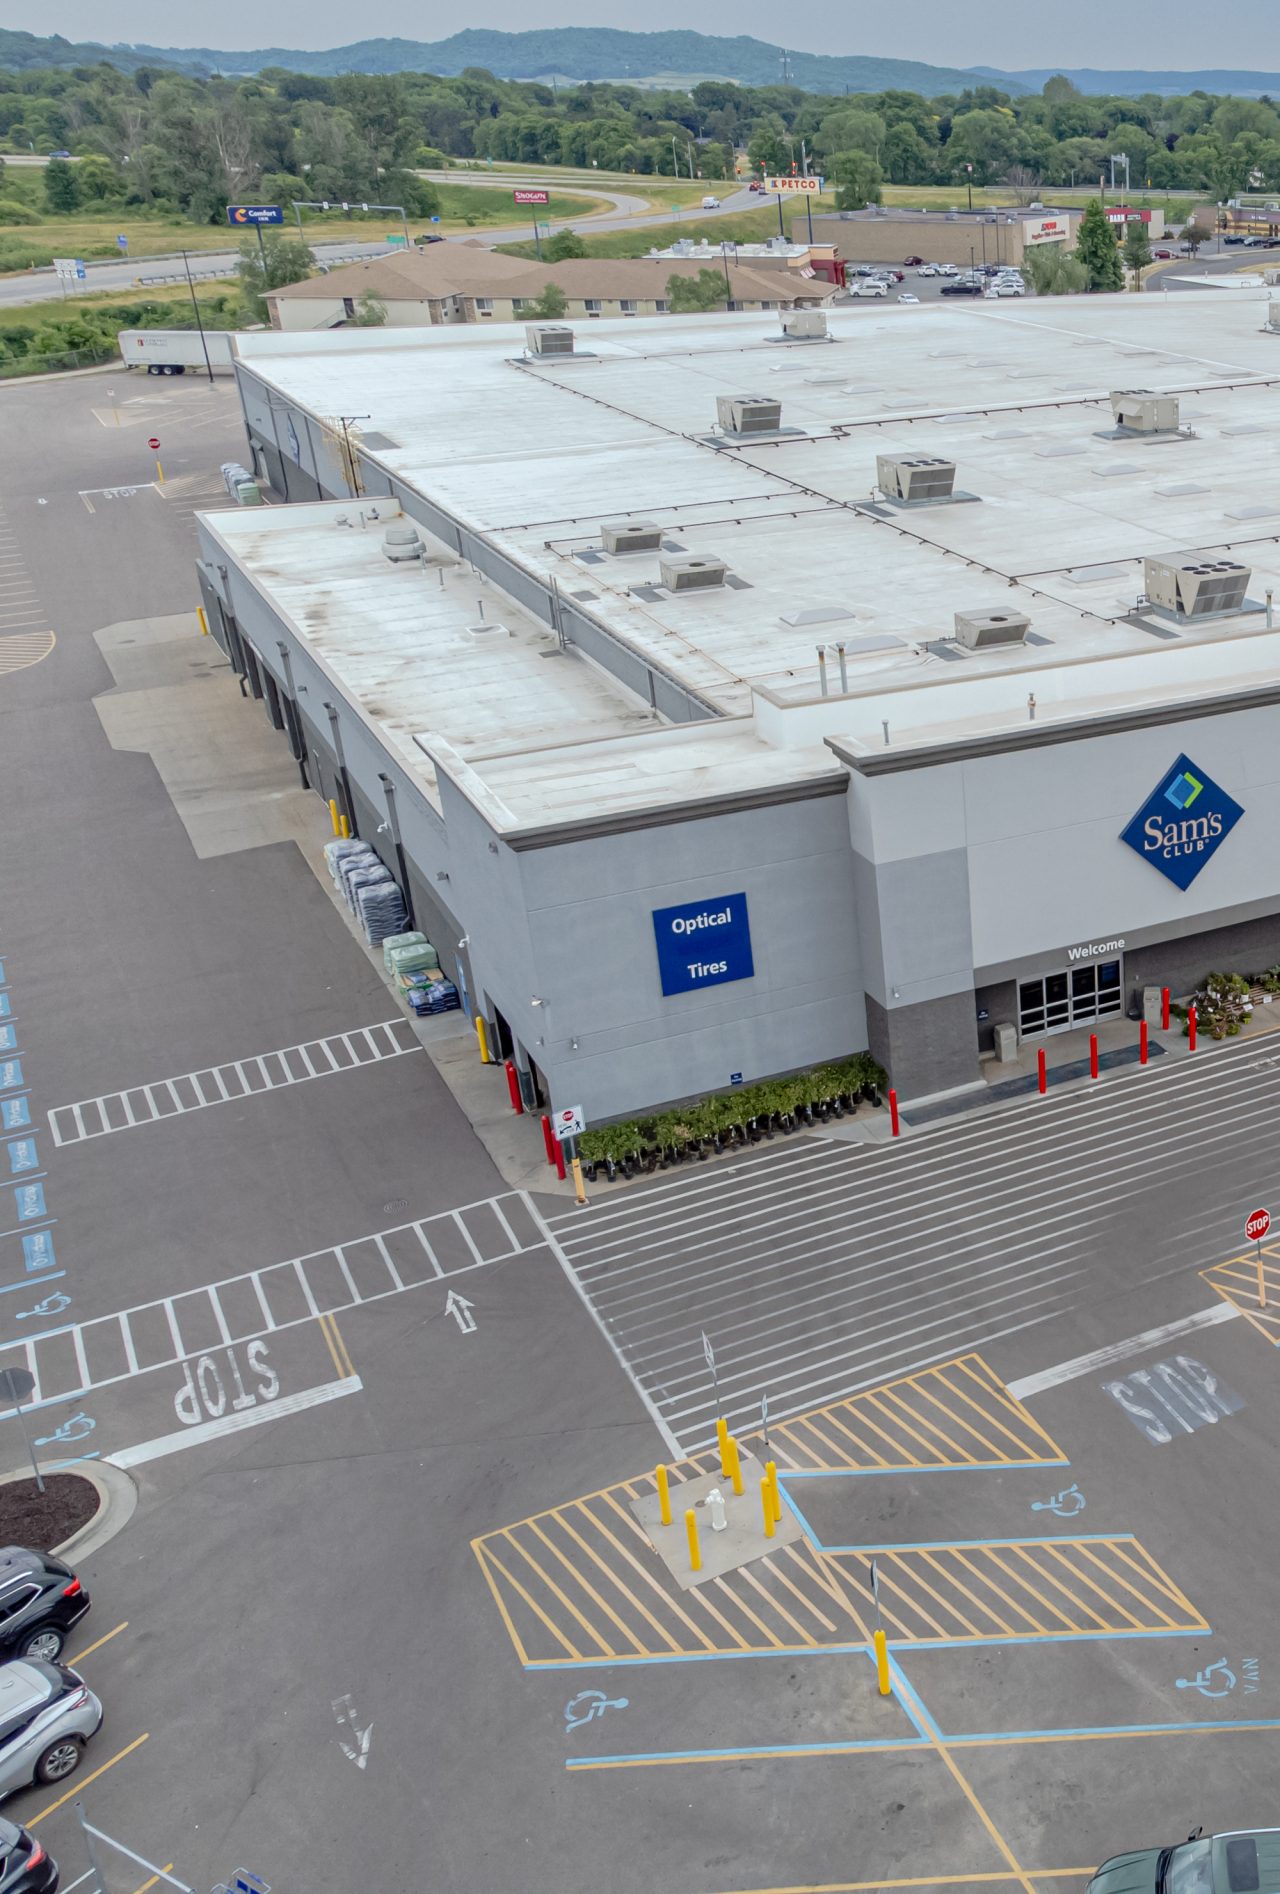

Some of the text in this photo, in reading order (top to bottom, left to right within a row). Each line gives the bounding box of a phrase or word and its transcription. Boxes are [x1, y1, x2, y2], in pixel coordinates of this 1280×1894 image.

[781, 180, 816, 189] PETCO
[103, 488, 137, 499] STOP
[1144, 811, 1222, 851] Sam's
[671, 907, 732, 935] Optical
[1067, 939, 1126, 961] Welcome
[687, 961, 728, 979] Tires
[1247, 1215, 1269, 1235] STOP
[173, 1340, 280, 1425] STOP
[1101, 1354, 1235, 1444] STOP
[1241, 1657, 1260, 1696] VAN
